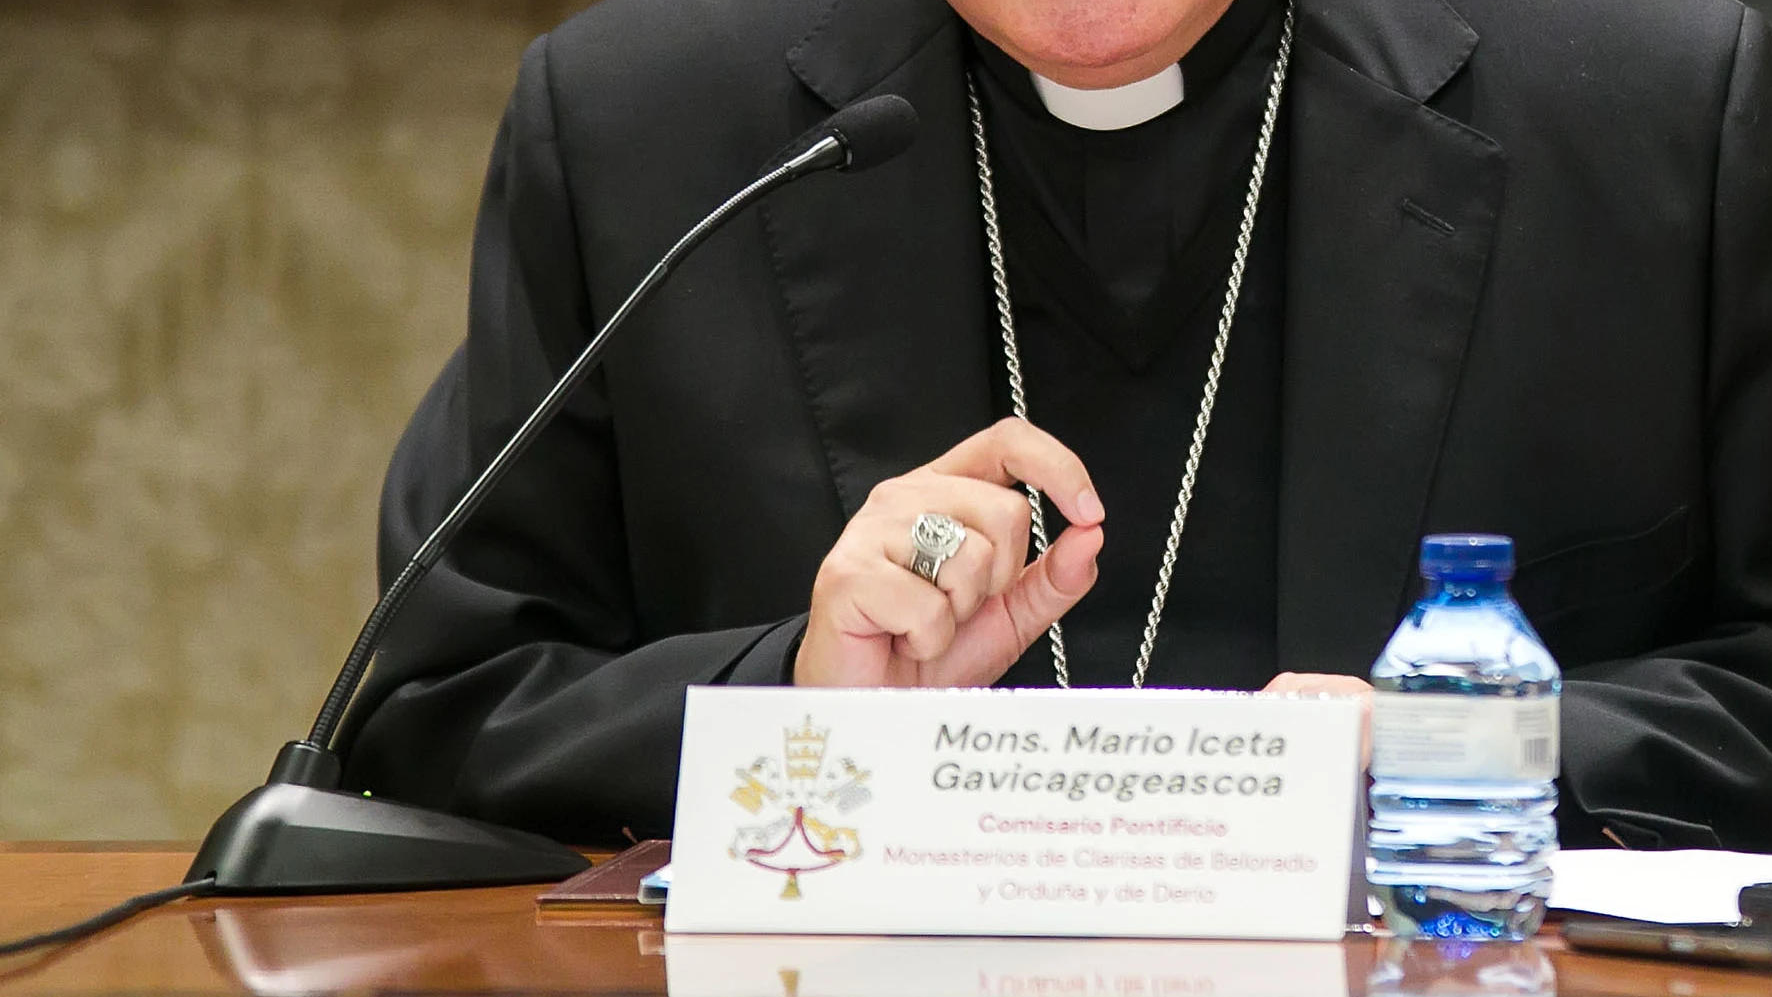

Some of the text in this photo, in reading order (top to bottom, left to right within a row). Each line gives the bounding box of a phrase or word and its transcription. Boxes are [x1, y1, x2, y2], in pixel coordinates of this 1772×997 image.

[934, 723, 1286, 757] Mons. Mario Iceta
[932, 762, 1285, 802] Gavicagogeascoa
[978, 814, 1104, 836] Comisario
[882, 845, 1318, 873] Monasterios de Clarisas de Belorado
[976, 884, 991, 902] y
[1094, 885, 1109, 904] y
[1115, 882, 1146, 903] de
[1153, 882, 1216, 904] Derio
